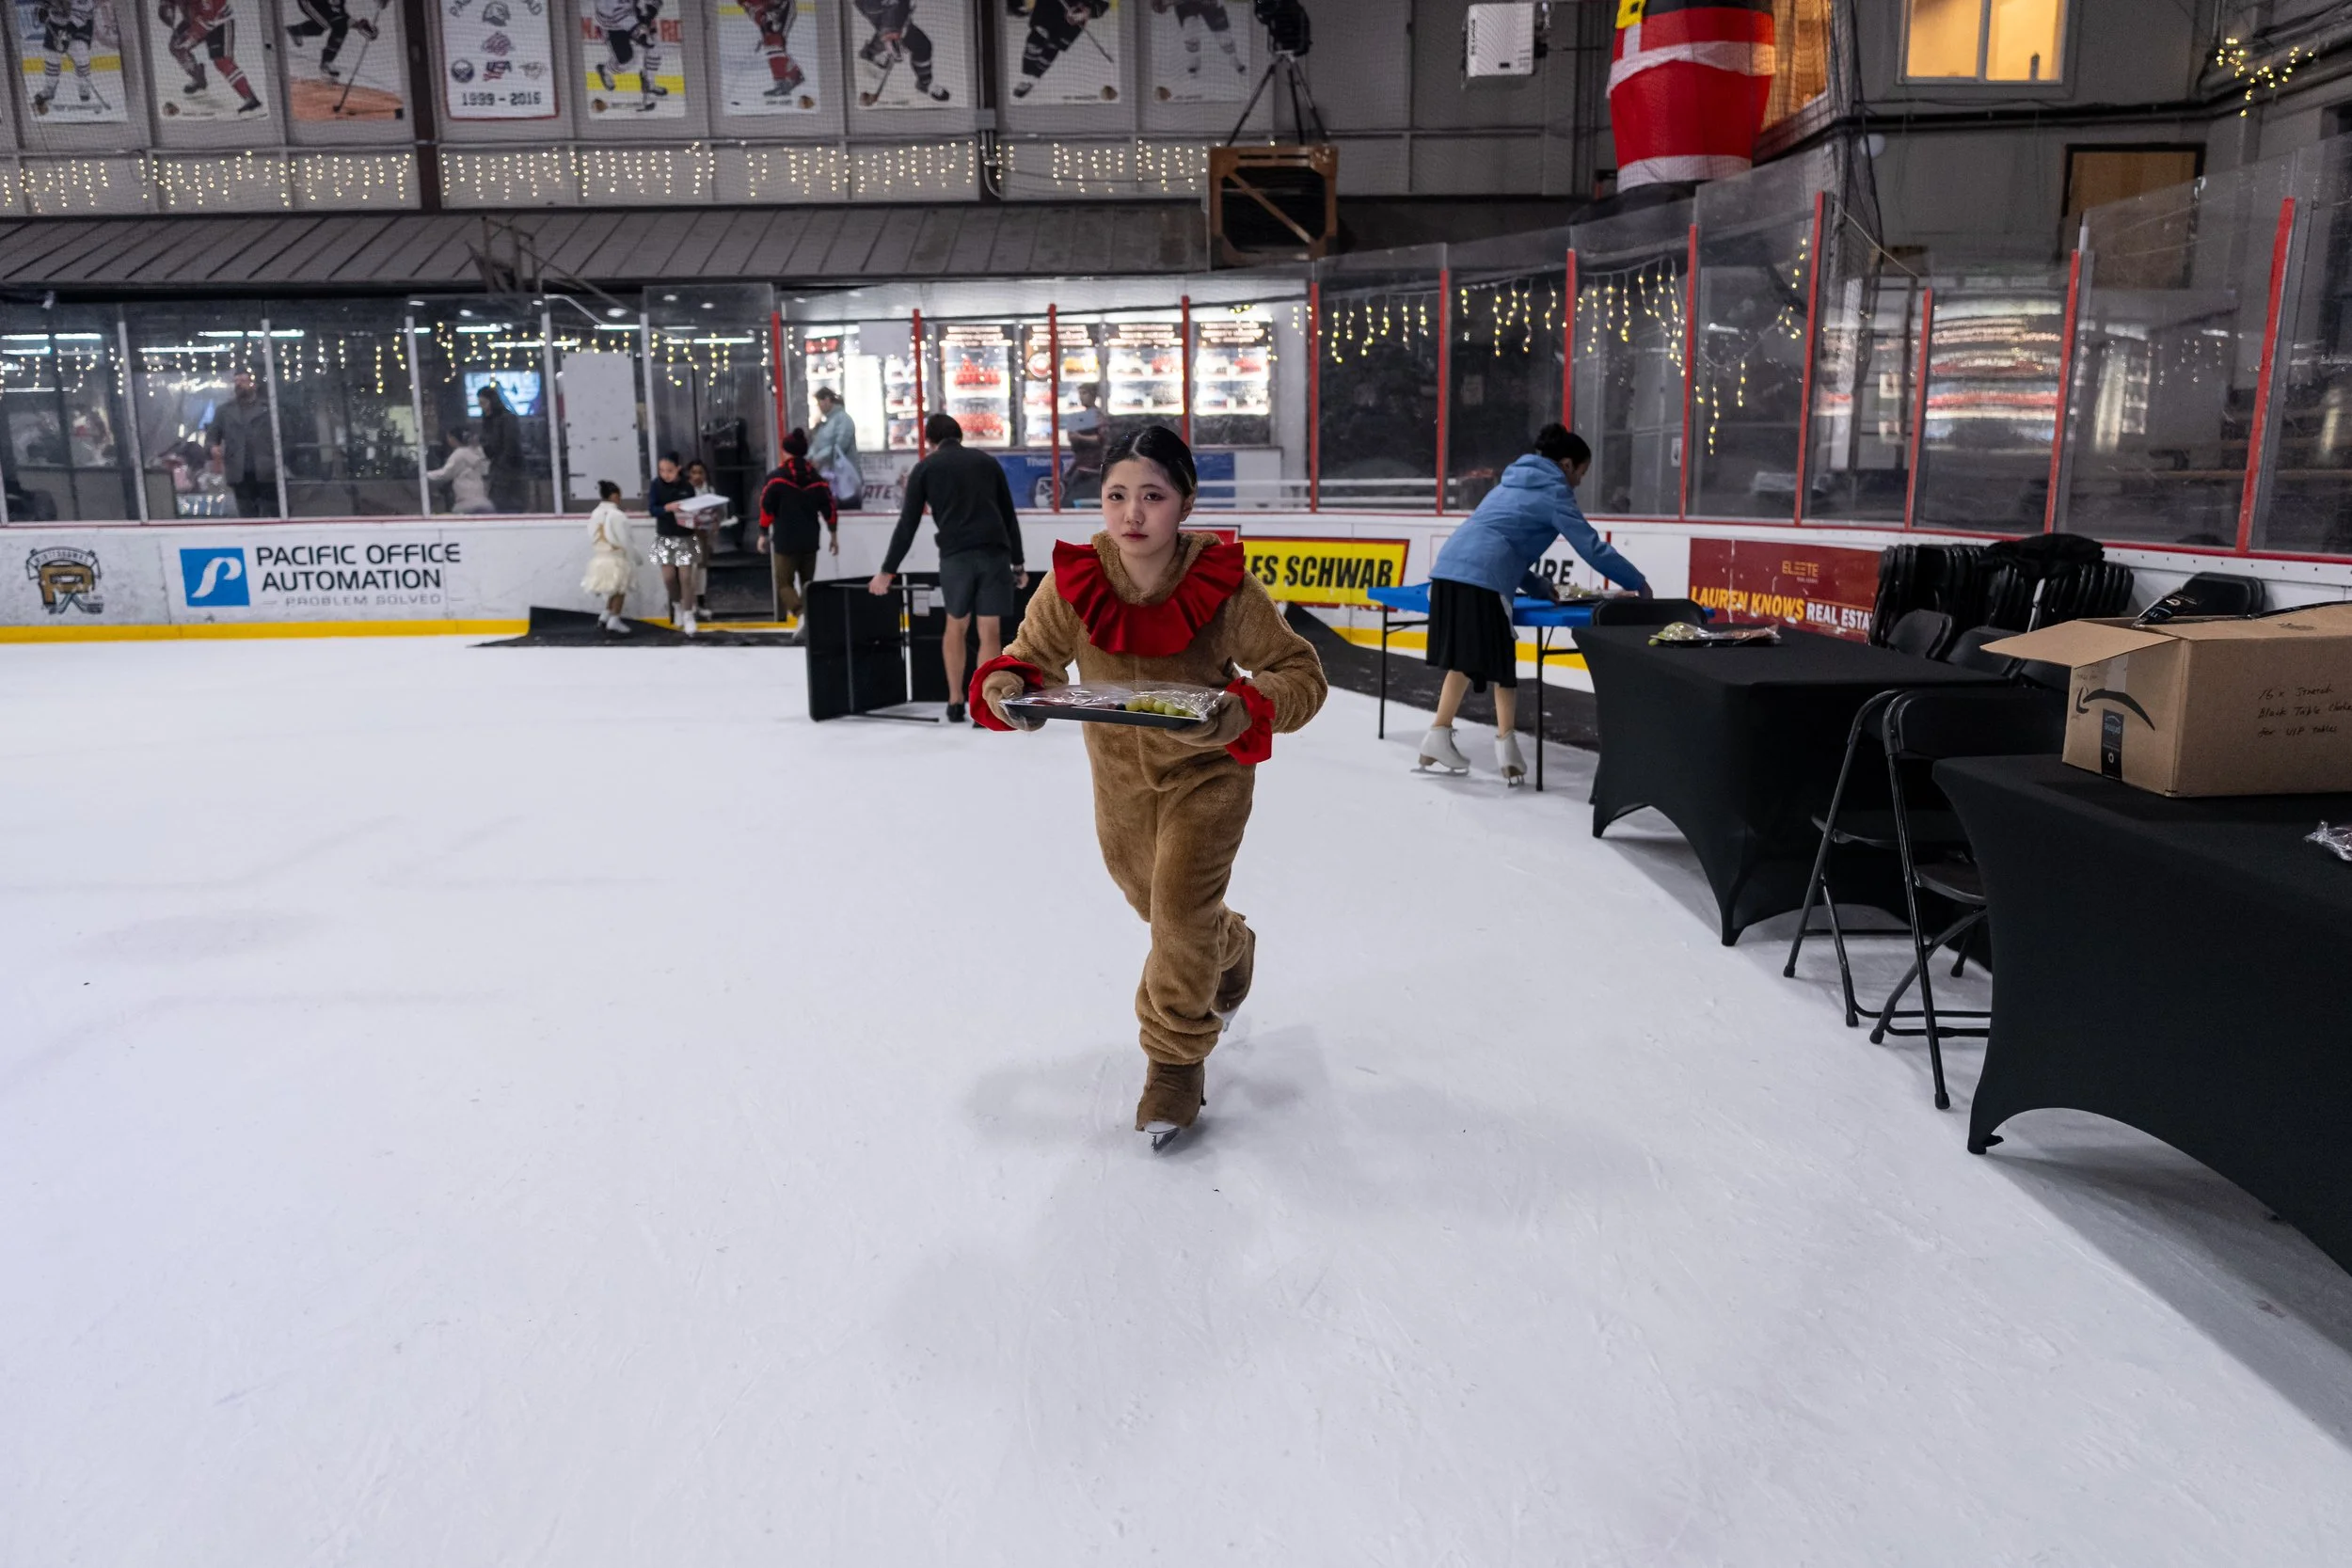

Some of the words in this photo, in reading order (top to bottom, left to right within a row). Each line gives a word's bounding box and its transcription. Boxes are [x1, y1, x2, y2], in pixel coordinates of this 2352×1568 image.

[462, 92, 496, 106] 1999
[863, 484, 895, 500] ATE
[255, 545, 358, 566] PACIFIC
[366, 543, 461, 564] OFFICE
[262, 569, 441, 592] AUTOMATION
[1244, 554, 1279, 586] ES
[1284, 555, 1393, 589] SCHWAB
[285, 594, 368, 607] PROBLEM
[375, 593, 441, 606] SOLVED
[1691, 586, 1748, 611] LAUREN
[1751, 592, 1805, 621] KNOWS
[1806, 602, 1837, 626] REAL
[1841, 608, 1874, 634] ESTA
